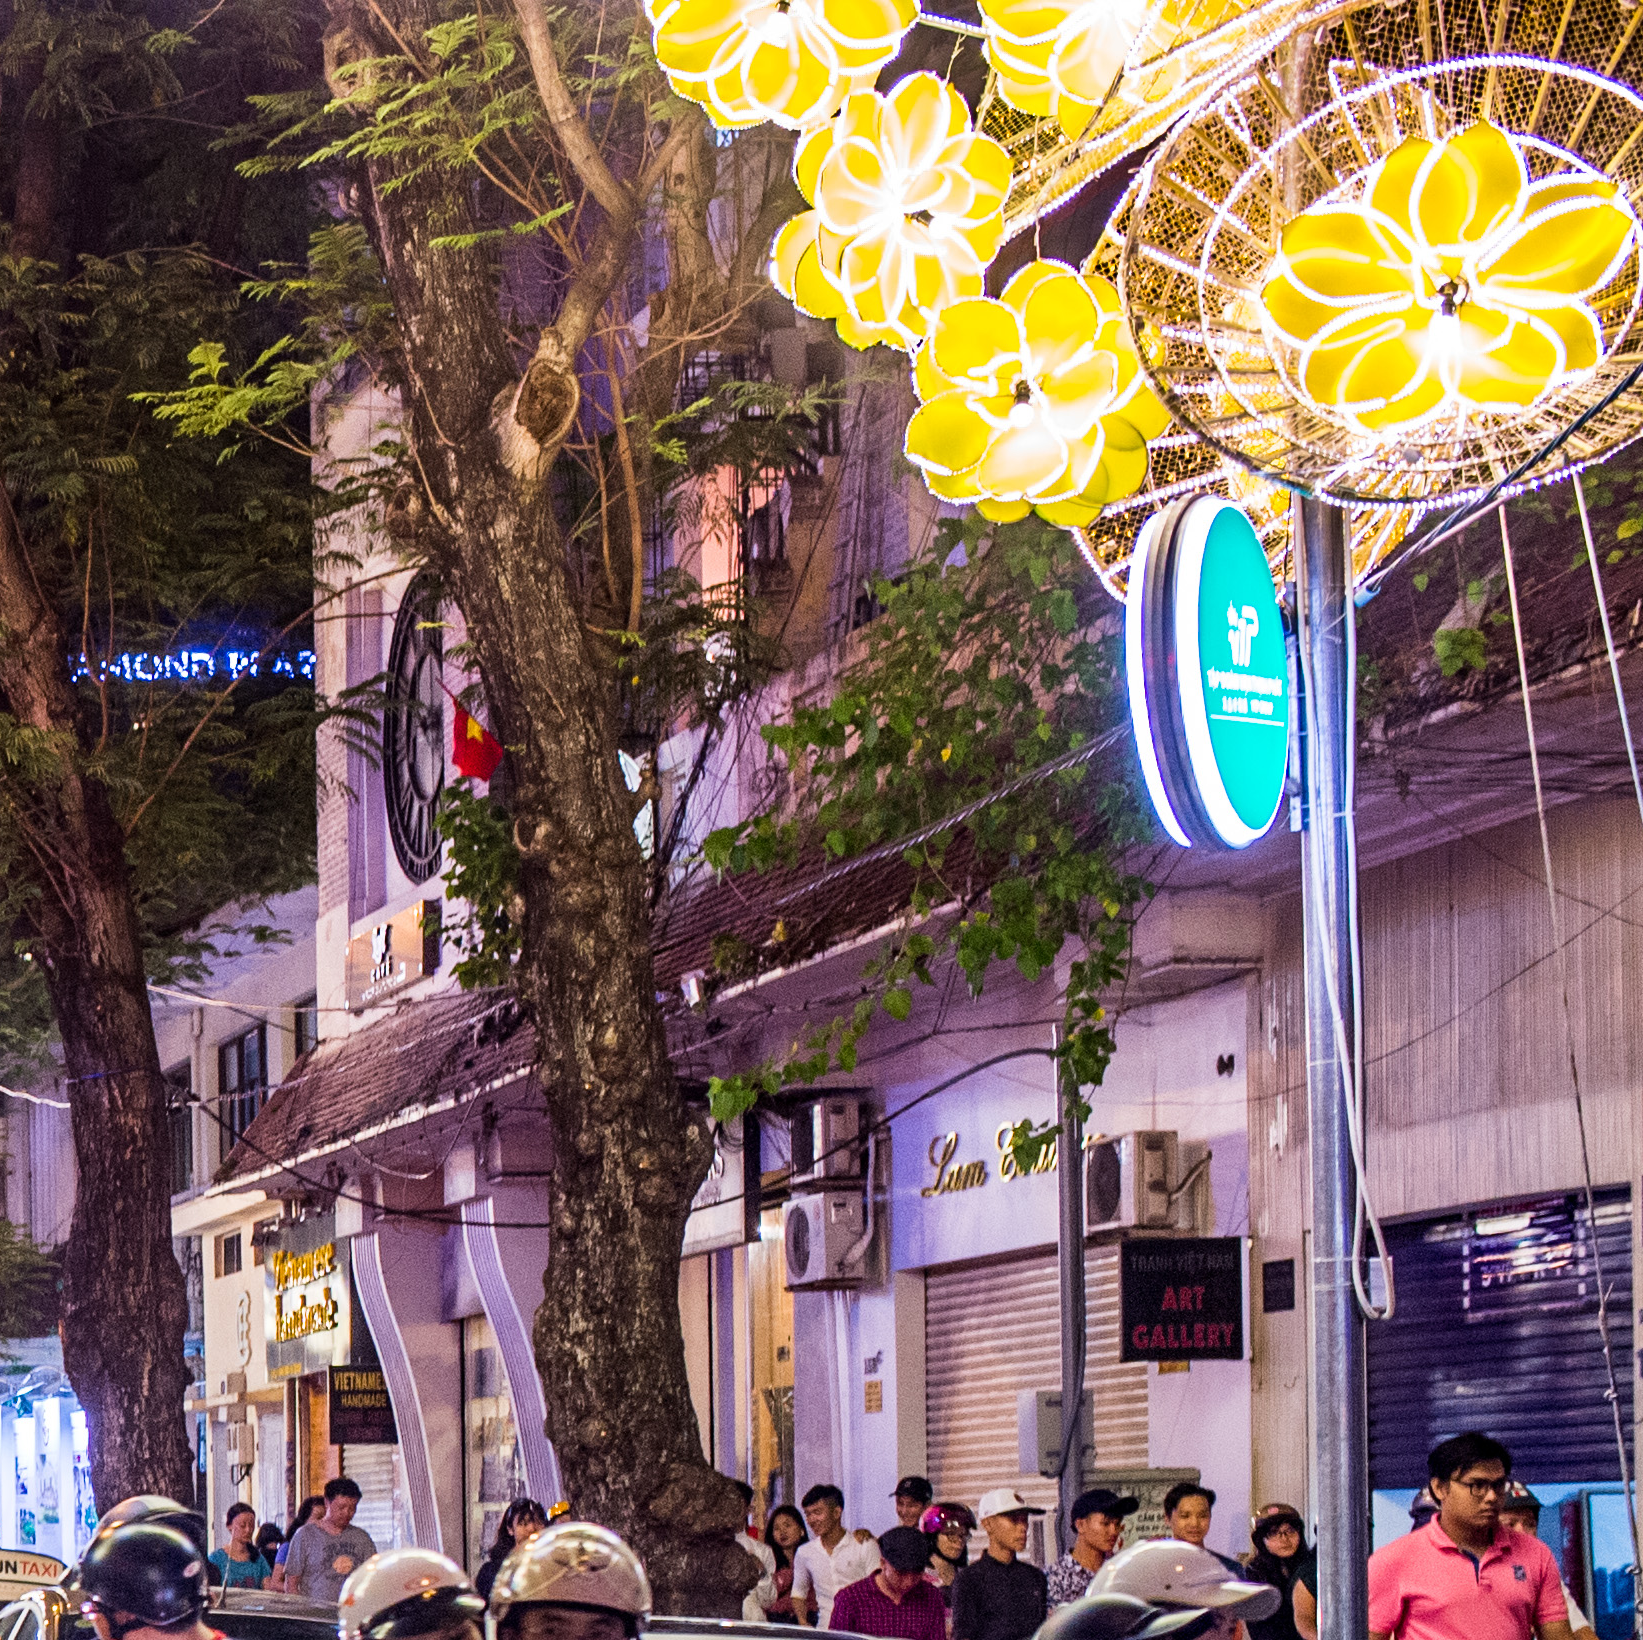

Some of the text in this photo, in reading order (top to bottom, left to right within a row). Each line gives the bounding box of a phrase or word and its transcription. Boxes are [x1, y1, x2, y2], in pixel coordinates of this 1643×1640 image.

[1161, 1286, 1205, 1311] ART
[1132, 1323, 1234, 1349] GALLERY
[19, 1561, 57, 1577] TAXI
